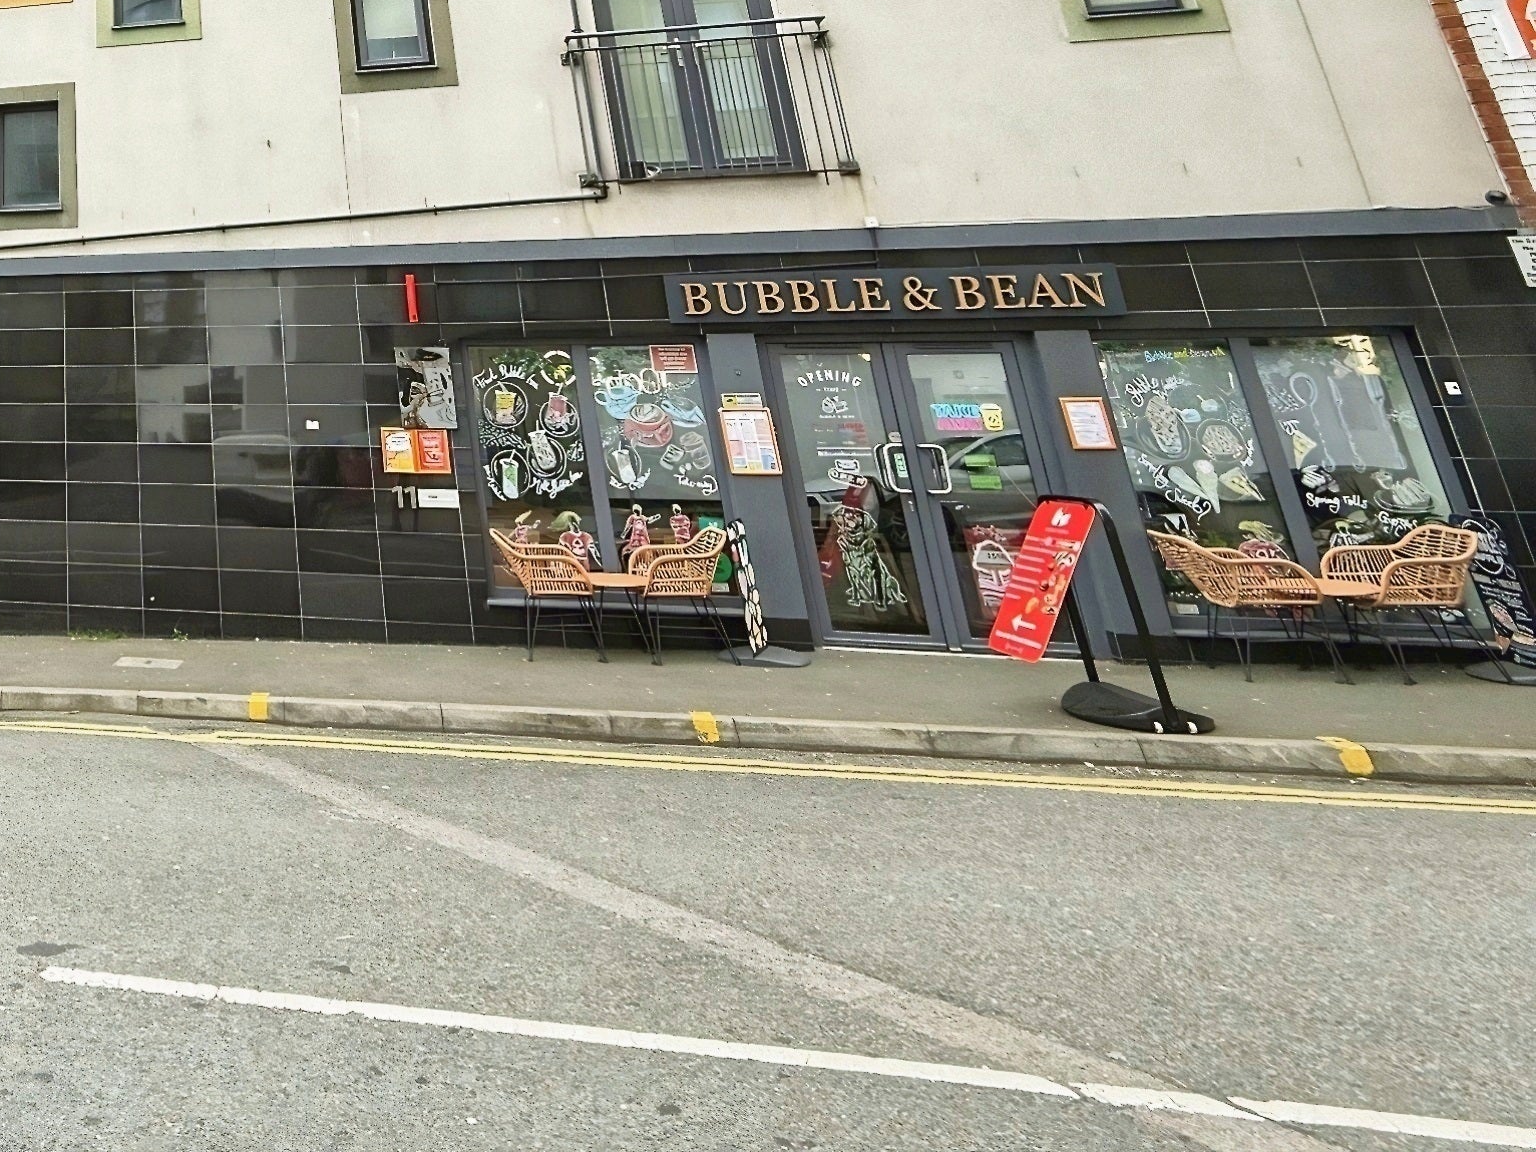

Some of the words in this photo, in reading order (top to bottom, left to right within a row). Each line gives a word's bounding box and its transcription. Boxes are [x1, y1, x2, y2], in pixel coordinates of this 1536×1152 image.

[680, 279, 891, 315] BUBBLE
[902, 276, 942, 310] &
[949, 272, 1104, 310] BEAN
[797, 369, 862, 387] OPENING
[391, 485, 417, 508] 11
